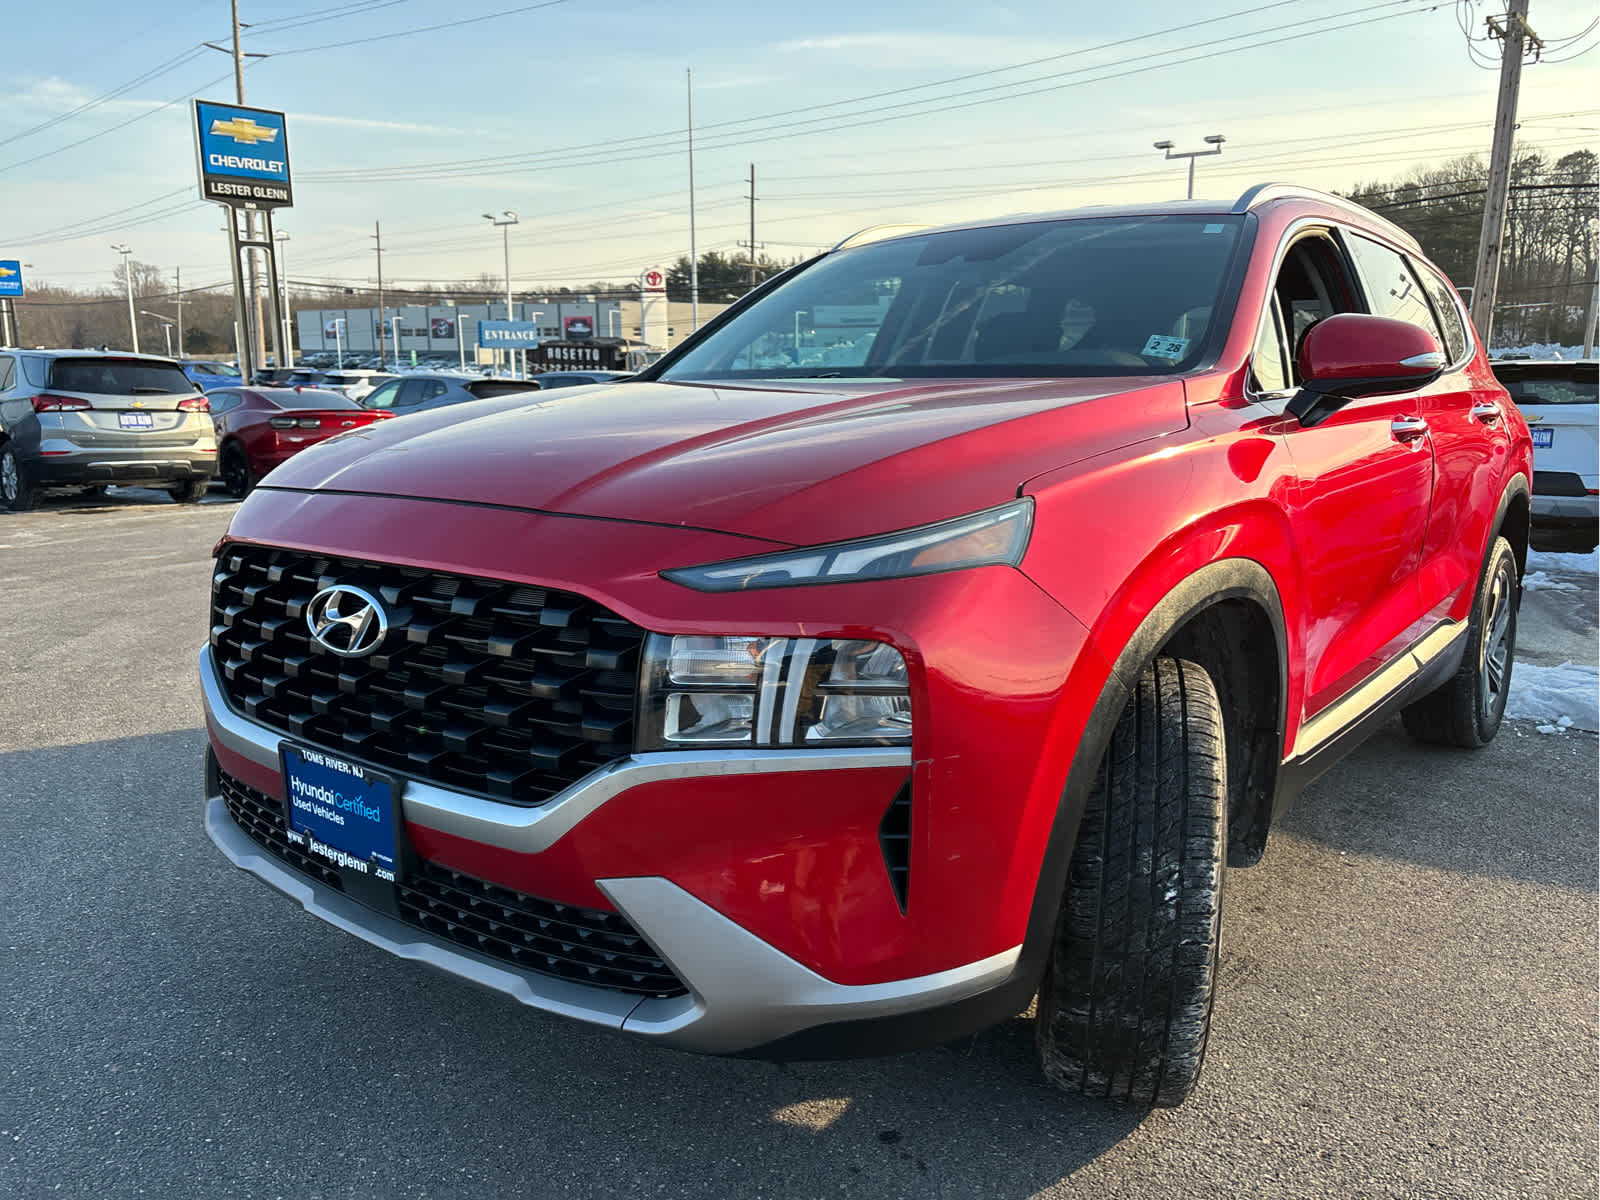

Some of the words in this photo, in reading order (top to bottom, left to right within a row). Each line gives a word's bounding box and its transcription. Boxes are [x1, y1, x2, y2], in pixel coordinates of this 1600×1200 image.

[209, 154, 285, 173] CHEVROLET
[211, 182, 252, 196] LESTER
[253, 186, 288, 200] GLENN
[484, 329, 536, 341] ENTRANCE
[547, 347, 600, 361] ROSETTO
[1150, 341, 1161, 350] 2
[1165, 343, 1182, 353] 28
[301, 749, 325, 765] TOMS
[352, 765, 364, 778] NJ
[292, 796, 312, 813] Used
[311, 802, 345, 826] Vehicles
[309, 837, 368, 874] lesterglenn
[375, 867, 395, 882] .com
